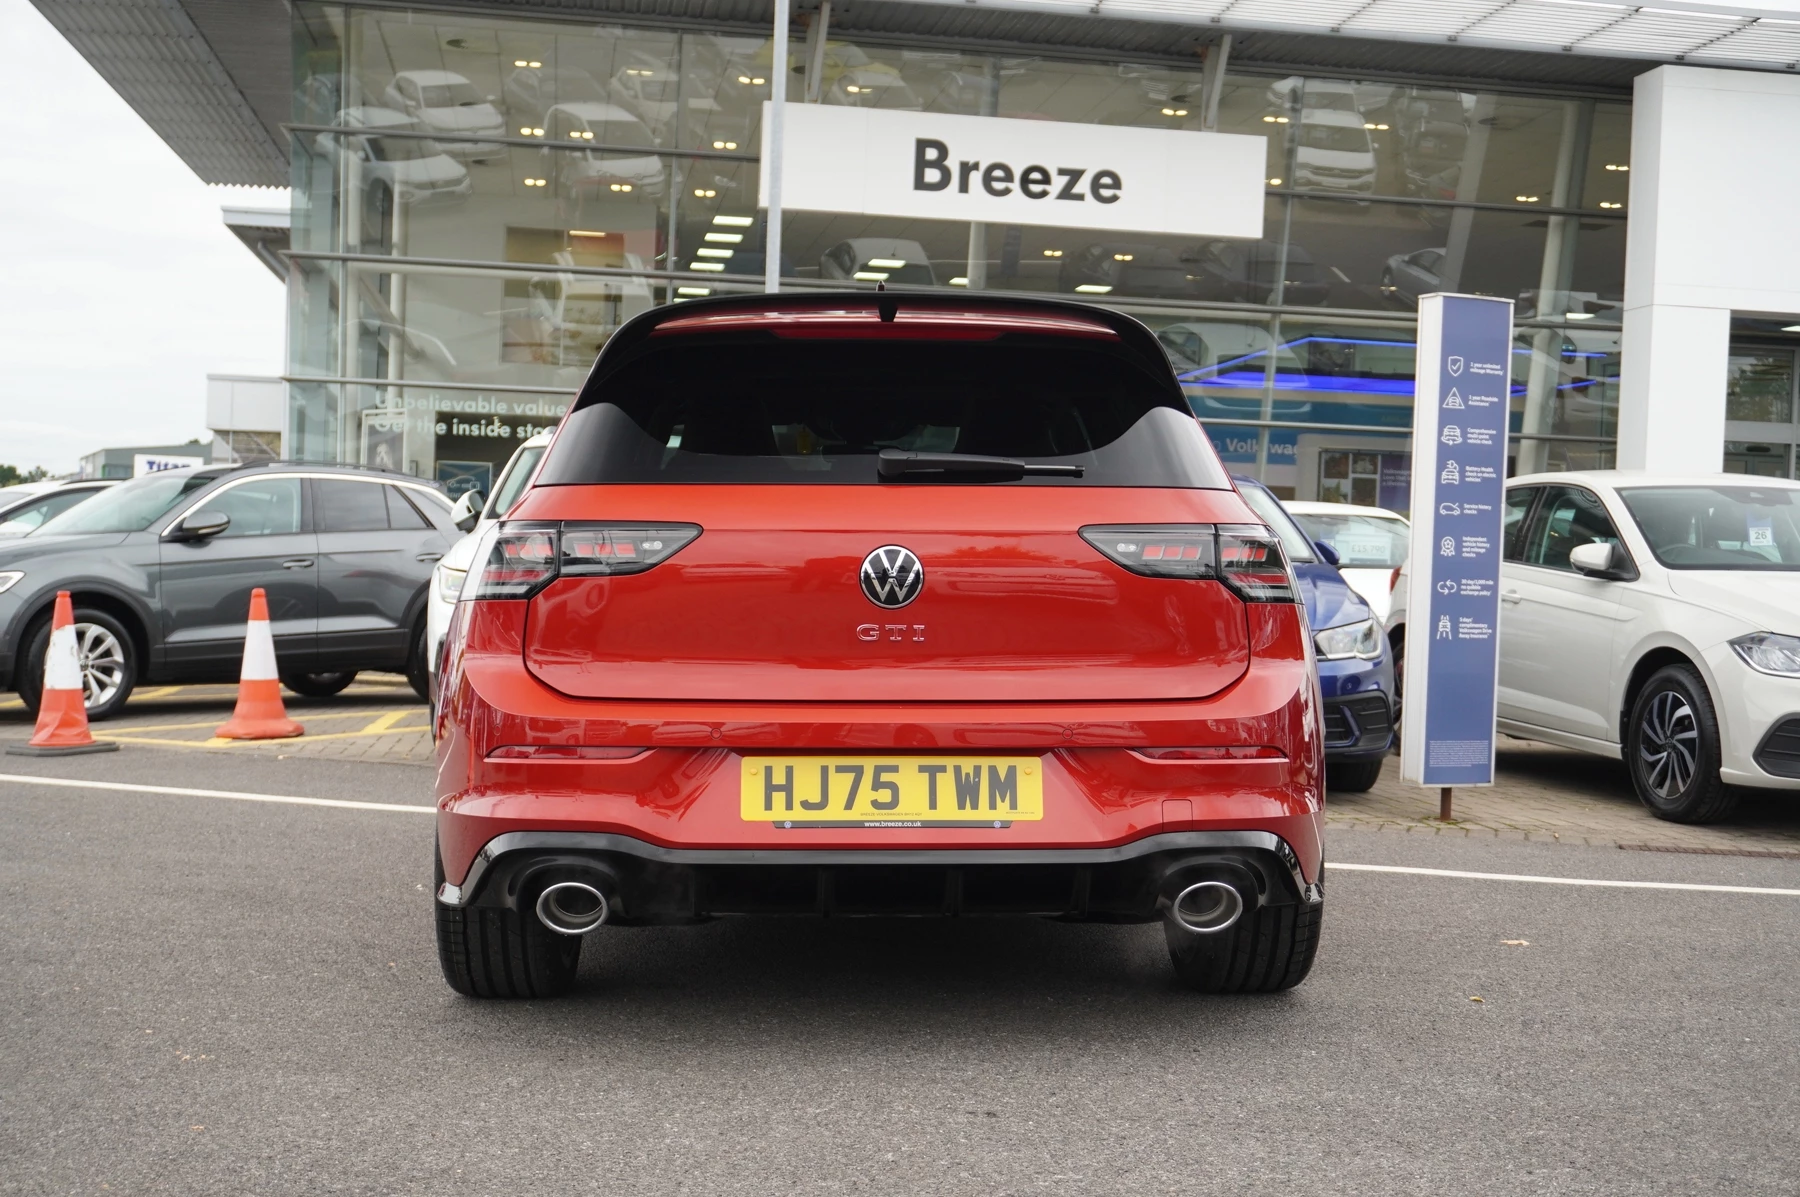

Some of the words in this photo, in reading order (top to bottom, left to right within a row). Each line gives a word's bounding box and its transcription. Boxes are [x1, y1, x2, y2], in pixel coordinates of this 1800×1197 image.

[913, 137, 1123, 205] Breeze
[375, 390, 507, 413] Unbelievable
[513, 400, 566, 416] value
[417, 416, 447, 435] the
[452, 418, 511, 437] inside
[1754, 531, 1768, 540] 26
[856, 624, 925, 641] GTI
[764, 765, 900, 811] HJ75
[918, 765, 1018, 811] TWM
[864, 820, 922, 828] www.breeze.co.uk
